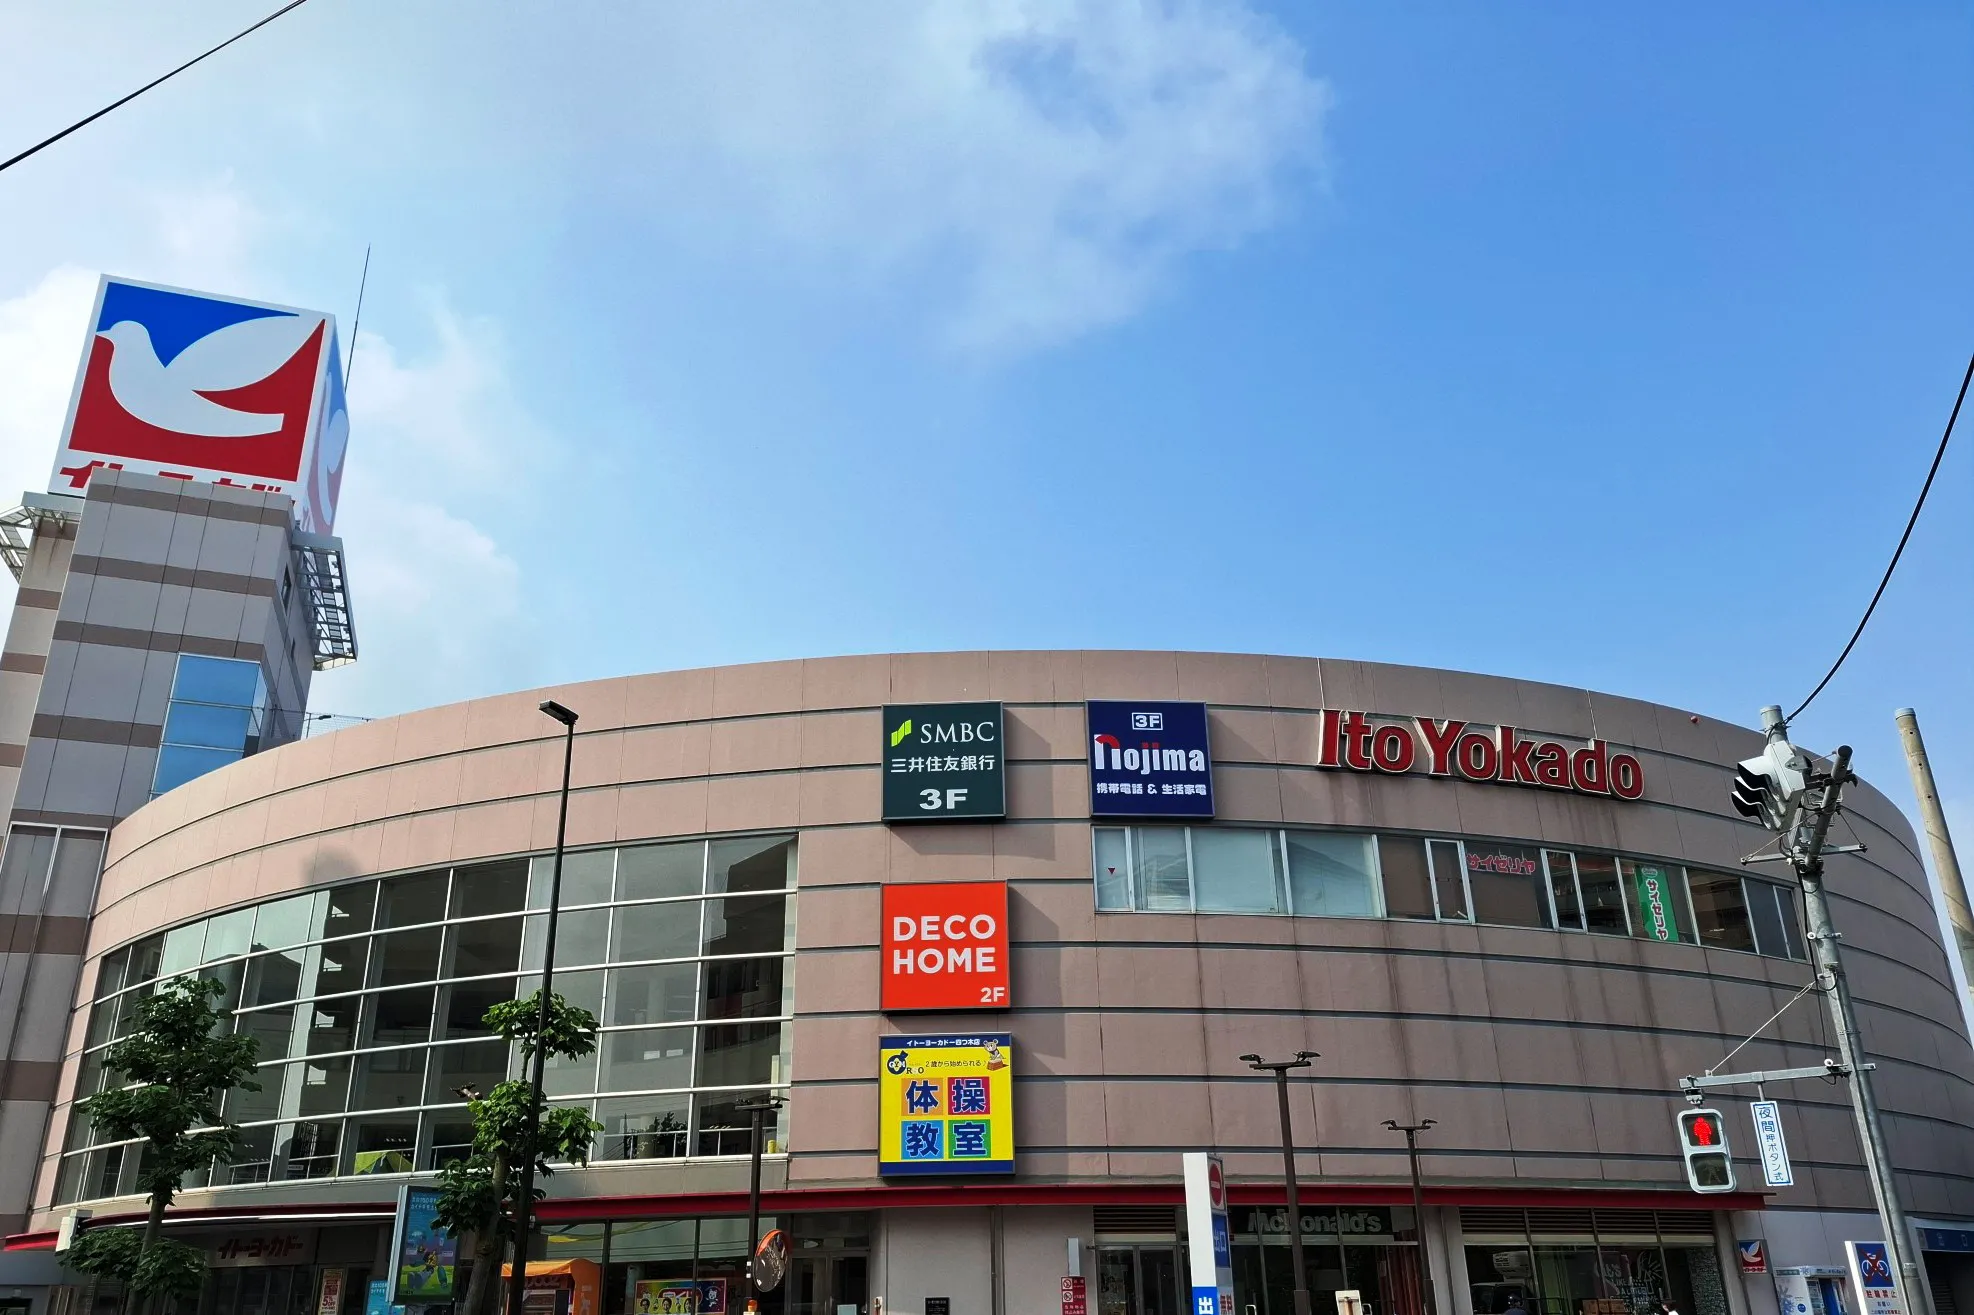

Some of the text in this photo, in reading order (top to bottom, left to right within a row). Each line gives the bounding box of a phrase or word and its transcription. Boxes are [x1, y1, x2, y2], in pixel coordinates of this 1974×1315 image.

[920, 721, 994, 744] SMBC
[1134, 714, 1161, 728] 3F
[890, 754, 995, 773] 三井住友銀行
[1094, 734, 1206, 775] nojima
[1319, 708, 1644, 799] Ito Yokado
[919, 788, 968, 810] 3F
[1096, 782, 1207, 796] 携帯電話 & 生活家電
[1466, 853, 1536, 875] サイゼリヤ
[1646, 878, 1668, 940] サイゼリヤ
[893, 914, 996, 942] DECO
[893, 947, 996, 975] HOME
[980, 987, 1005, 1002] 2F
[906, 1038, 981, 1047] イトーヨーカドー四つ木店
[905, 1079, 986, 1114] 体操
[905, 1121, 986, 1157] 教室
[1756, 1106, 1784, 1181] 夜間押ボタン式
